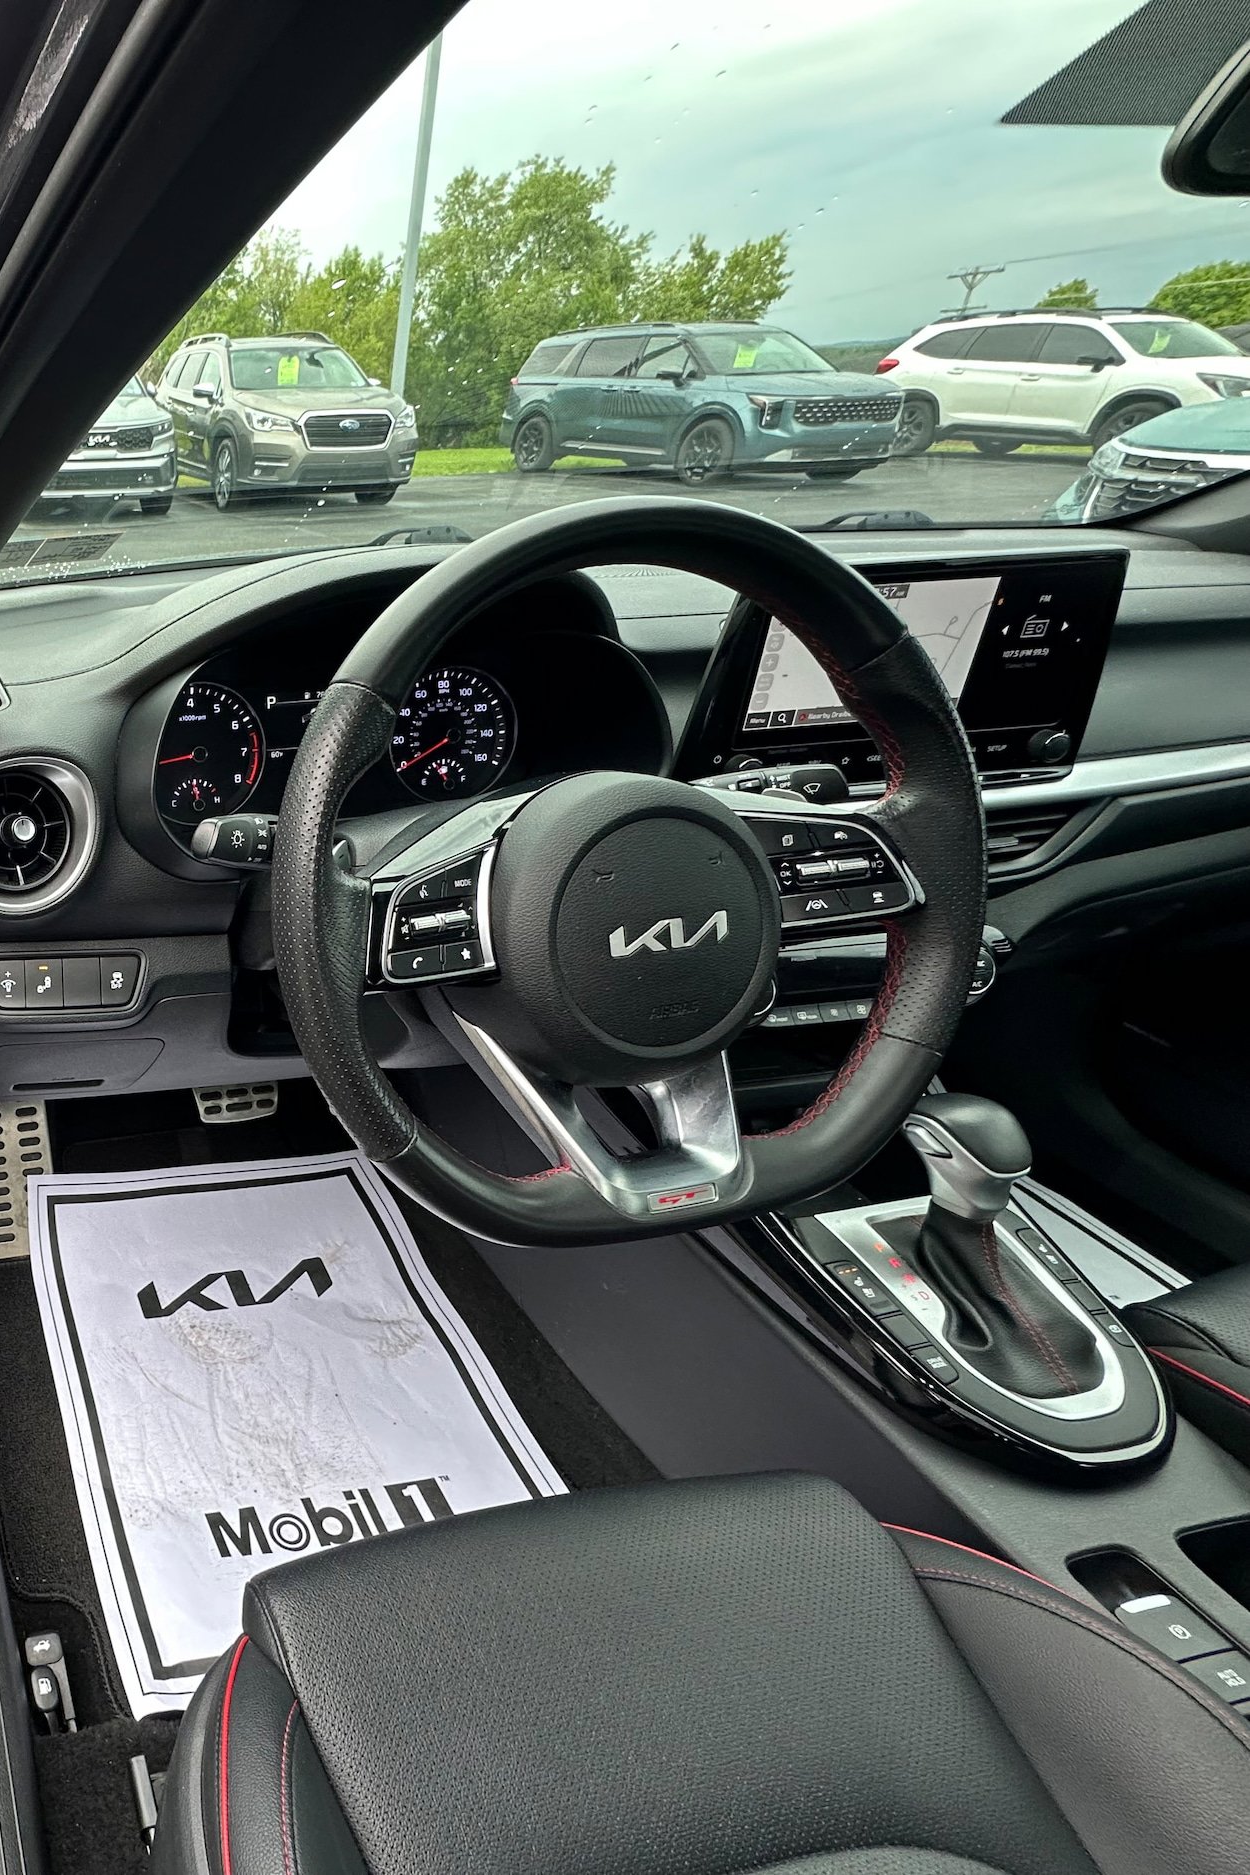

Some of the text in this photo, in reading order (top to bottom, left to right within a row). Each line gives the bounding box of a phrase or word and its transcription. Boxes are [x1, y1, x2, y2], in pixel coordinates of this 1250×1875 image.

[1039, 595, 1051, 603] FM
[437, 680, 450, 688] 80
[415, 690, 427, 698] 60
[459, 688, 472, 696] 100
[186, 698, 194, 708] 4
[266, 696, 276, 709] P
[213, 704, 220, 713] 5
[474, 704, 487, 712] 120
[231, 721, 239, 730] 6
[480, 729, 493, 737] 140
[392, 736, 404, 744] 20
[241, 748, 247, 757] 7
[474, 753, 488, 762] 160
[234, 774, 242, 783] 8
[421, 778, 427, 786] E
[171, 800, 177, 808] C
[780, 870, 792, 878] OK
[454, 878, 471, 888] MODE
[609, 909, 728, 957] KIA
[137, 1256, 332, 1319] KIA
[918, 1291, 930, 1300] D
[204, 1488, 388, 1558] Mobil
